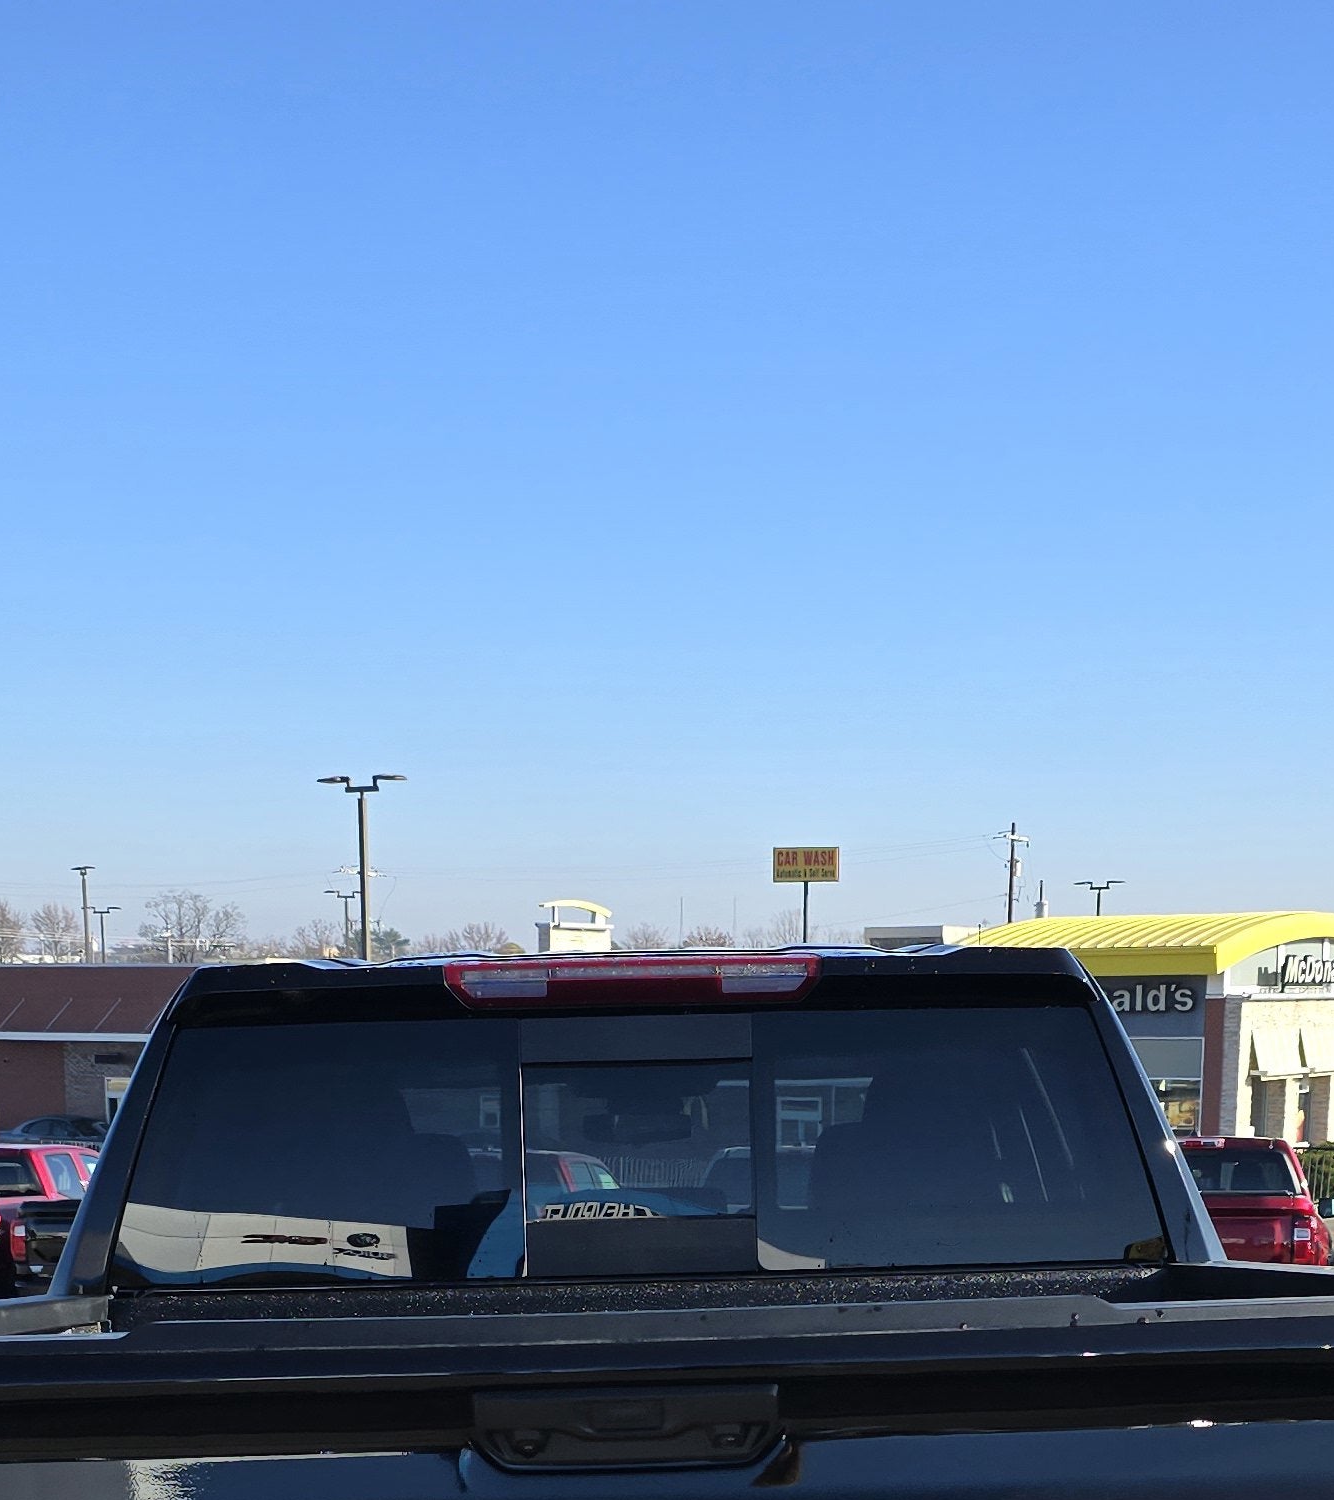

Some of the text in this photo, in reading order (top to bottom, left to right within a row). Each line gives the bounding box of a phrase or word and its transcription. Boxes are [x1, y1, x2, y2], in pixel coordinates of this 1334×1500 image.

[777, 850, 834, 867] CAR WASH
[1113, 984, 1193, 1012] ald's
